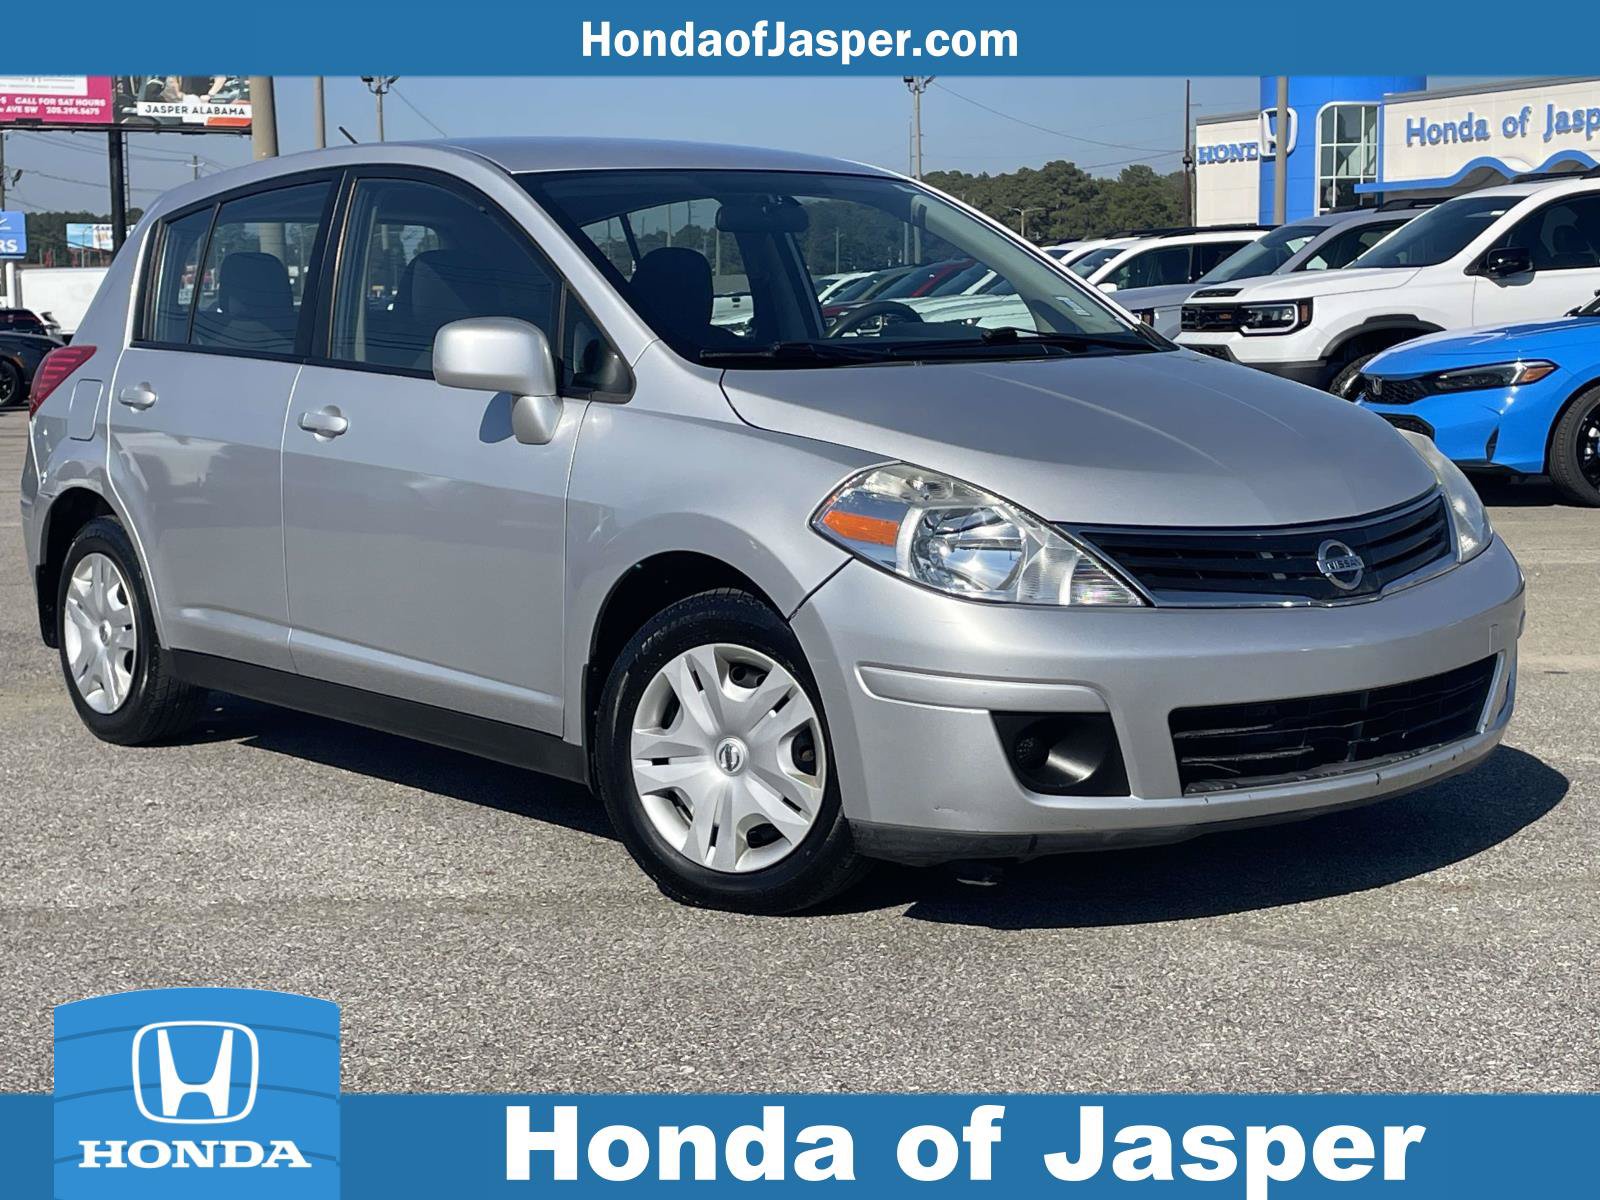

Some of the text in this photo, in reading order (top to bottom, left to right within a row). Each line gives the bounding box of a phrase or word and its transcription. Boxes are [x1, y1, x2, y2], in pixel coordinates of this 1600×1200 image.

[14, 97, 37, 105] CALL
[39, 97, 57, 106] FOR
[58, 98, 74, 106] SAT
[76, 98, 106, 107] HOURS
[6, 106, 23, 114] AVE
[24, 106, 38, 114] SW
[145, 105, 245, 115] JASPER ALABAMA
[1406, 103, 1600, 147] Honda of Jasp
